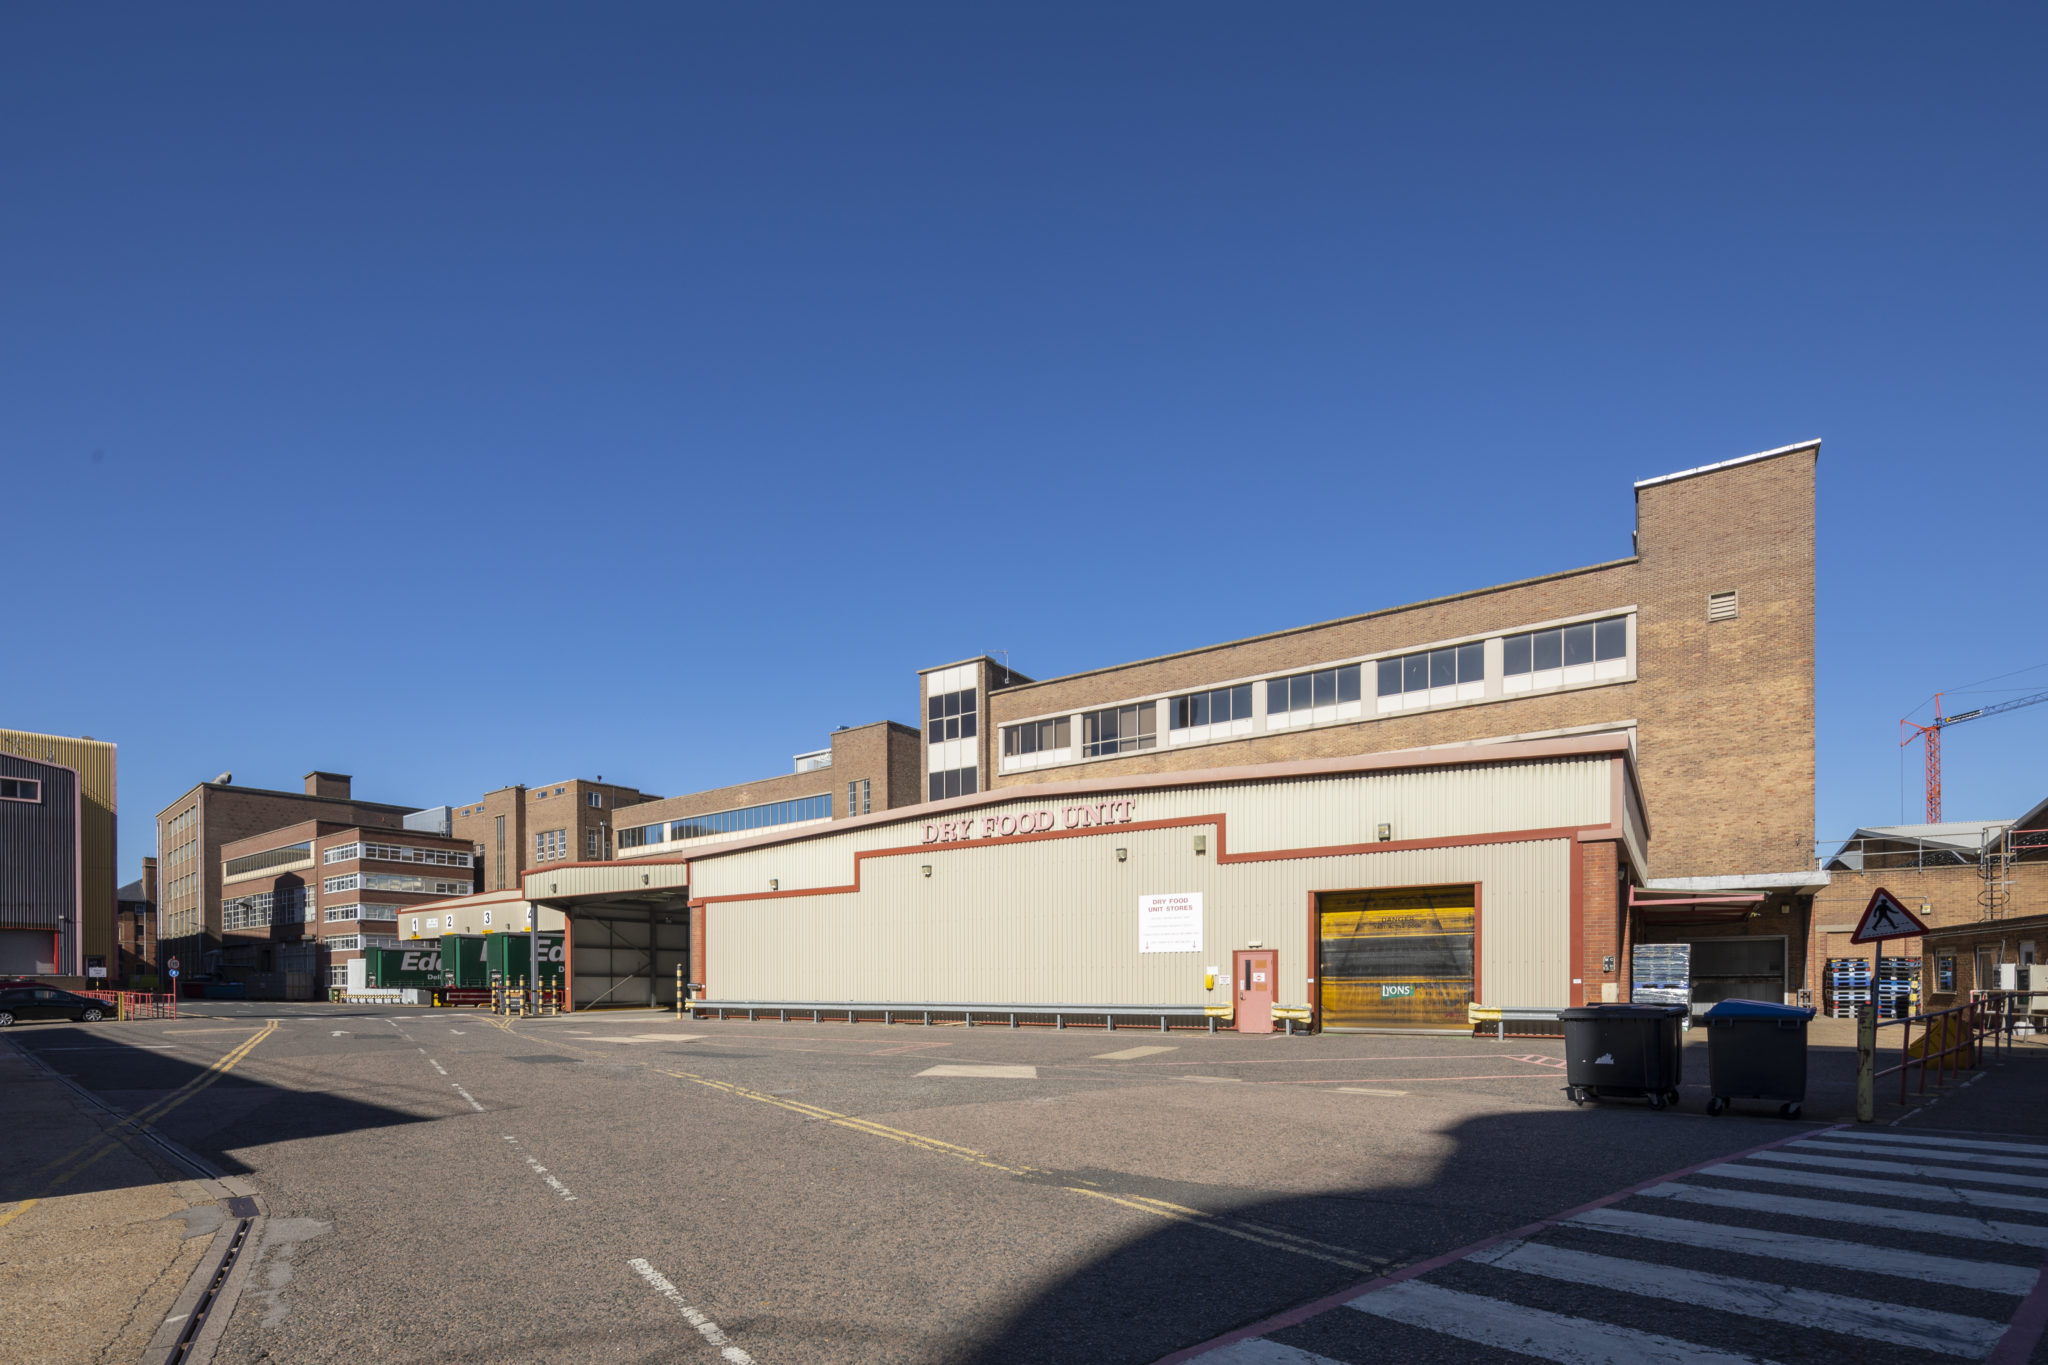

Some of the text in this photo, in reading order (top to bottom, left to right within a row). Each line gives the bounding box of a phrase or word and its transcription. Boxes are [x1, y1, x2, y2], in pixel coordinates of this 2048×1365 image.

[921, 799, 1135, 844] DRY FOOD UNIT
